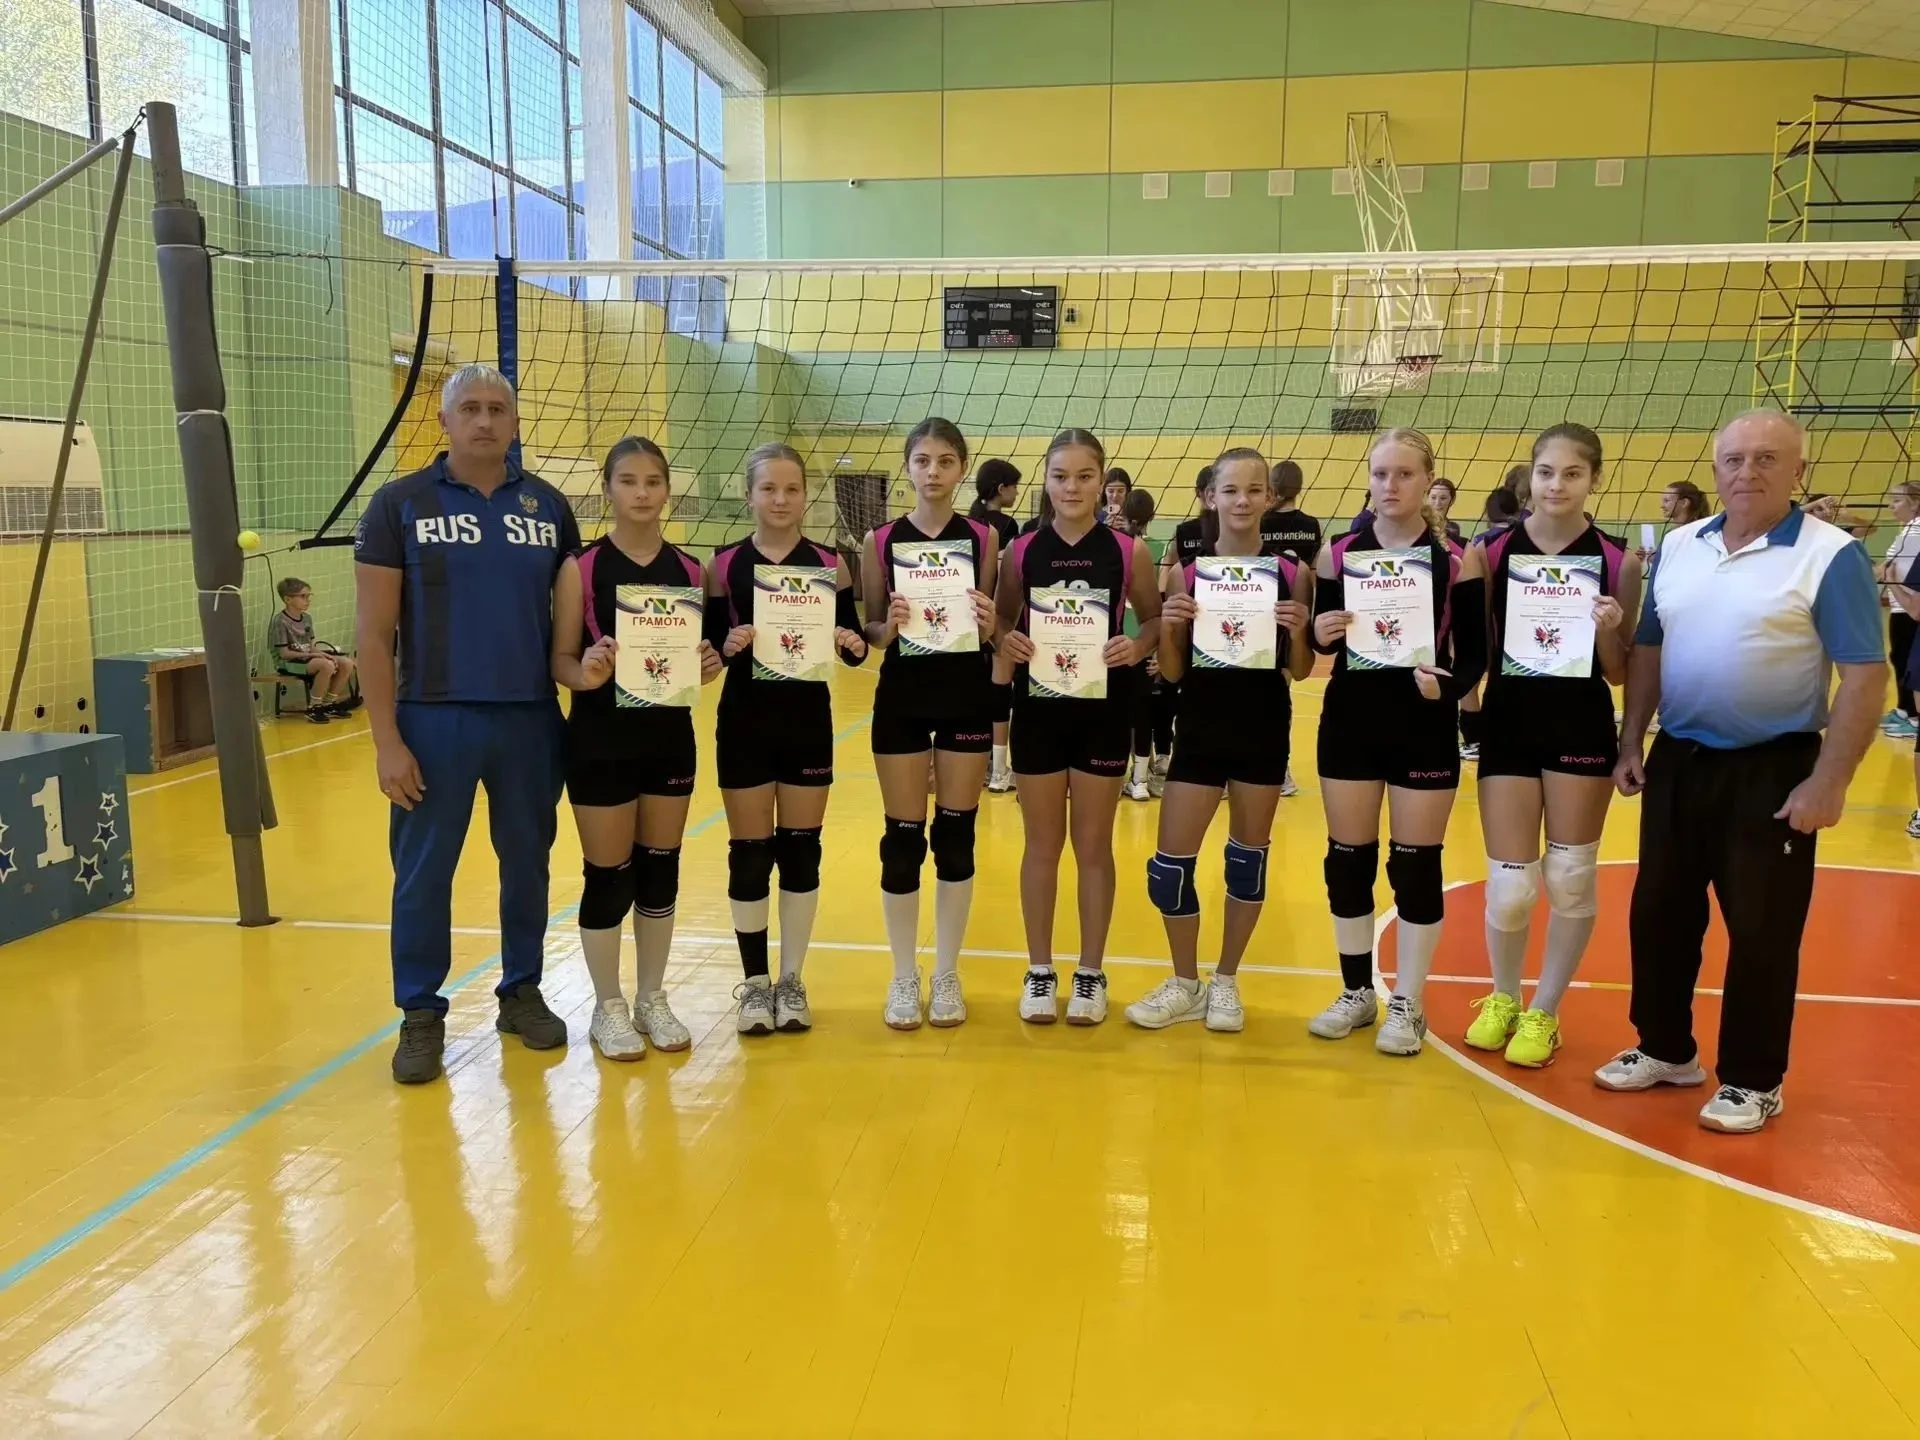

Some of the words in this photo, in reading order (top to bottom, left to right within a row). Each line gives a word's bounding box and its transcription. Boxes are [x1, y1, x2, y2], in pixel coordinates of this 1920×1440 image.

[415, 513, 481, 544] RUS
[503, 514, 557, 548] SIA
[1051, 559, 1092, 568] GIVOVA
[909, 568, 960, 579] ГРАМОТА
[1210, 583, 1263, 592] ГРАМОТА
[1361, 577, 1416, 590] ГРАМОТА
[1524, 586, 1582, 596] ГРАМОТА
[769, 594, 821, 605] ГРАМОТА
[632, 616, 687, 626] ГРАМОТА
[1044, 615, 1095, 625] ГРАМОТА
[1560, 755, 1606, 764] GIVOVA
[31, 776, 75, 869] 1
